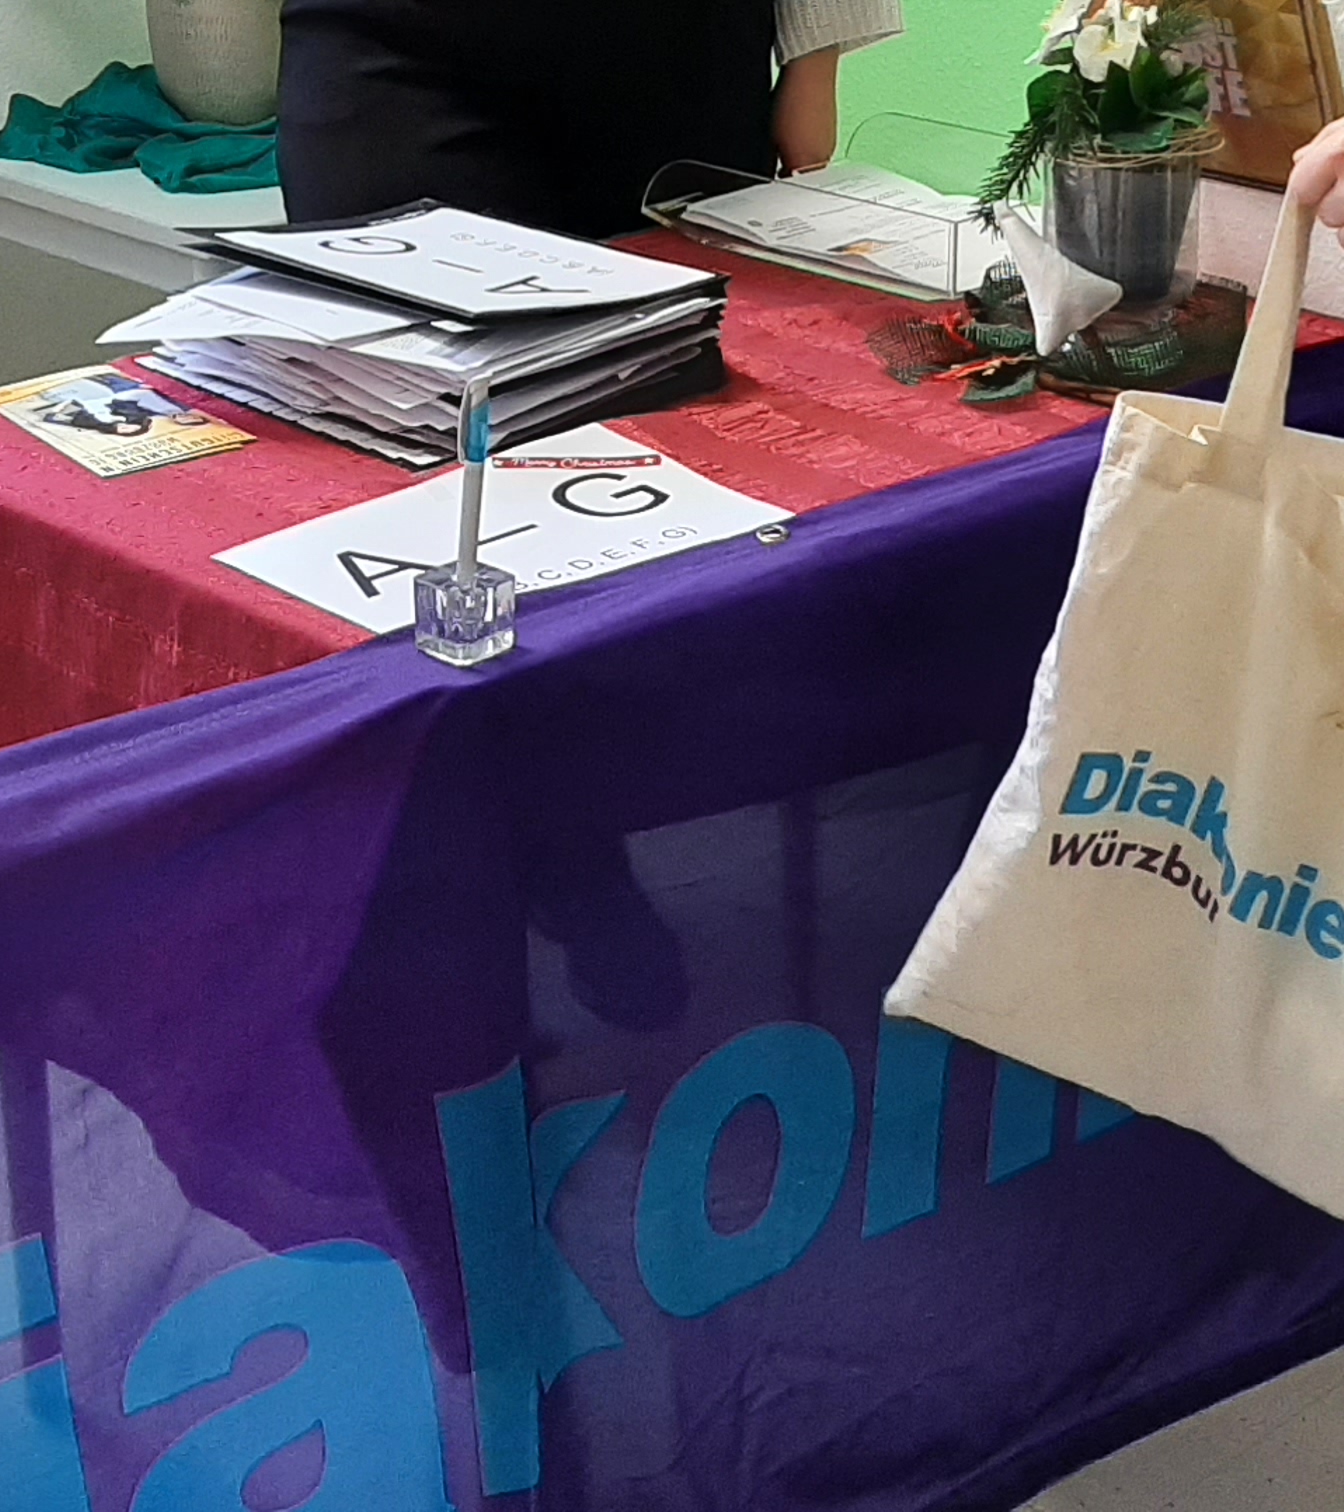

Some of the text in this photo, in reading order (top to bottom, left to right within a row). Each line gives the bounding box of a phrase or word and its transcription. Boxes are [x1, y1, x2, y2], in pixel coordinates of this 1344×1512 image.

[317, 236, 418, 255] G
[484, 275, 592, 295] A
[560, 457, 637, 469] Christmas
[337, 550, 442, 600] A
[552, 472, 671, 518] G
[1049, 829, 1220, 923] Würzbur
